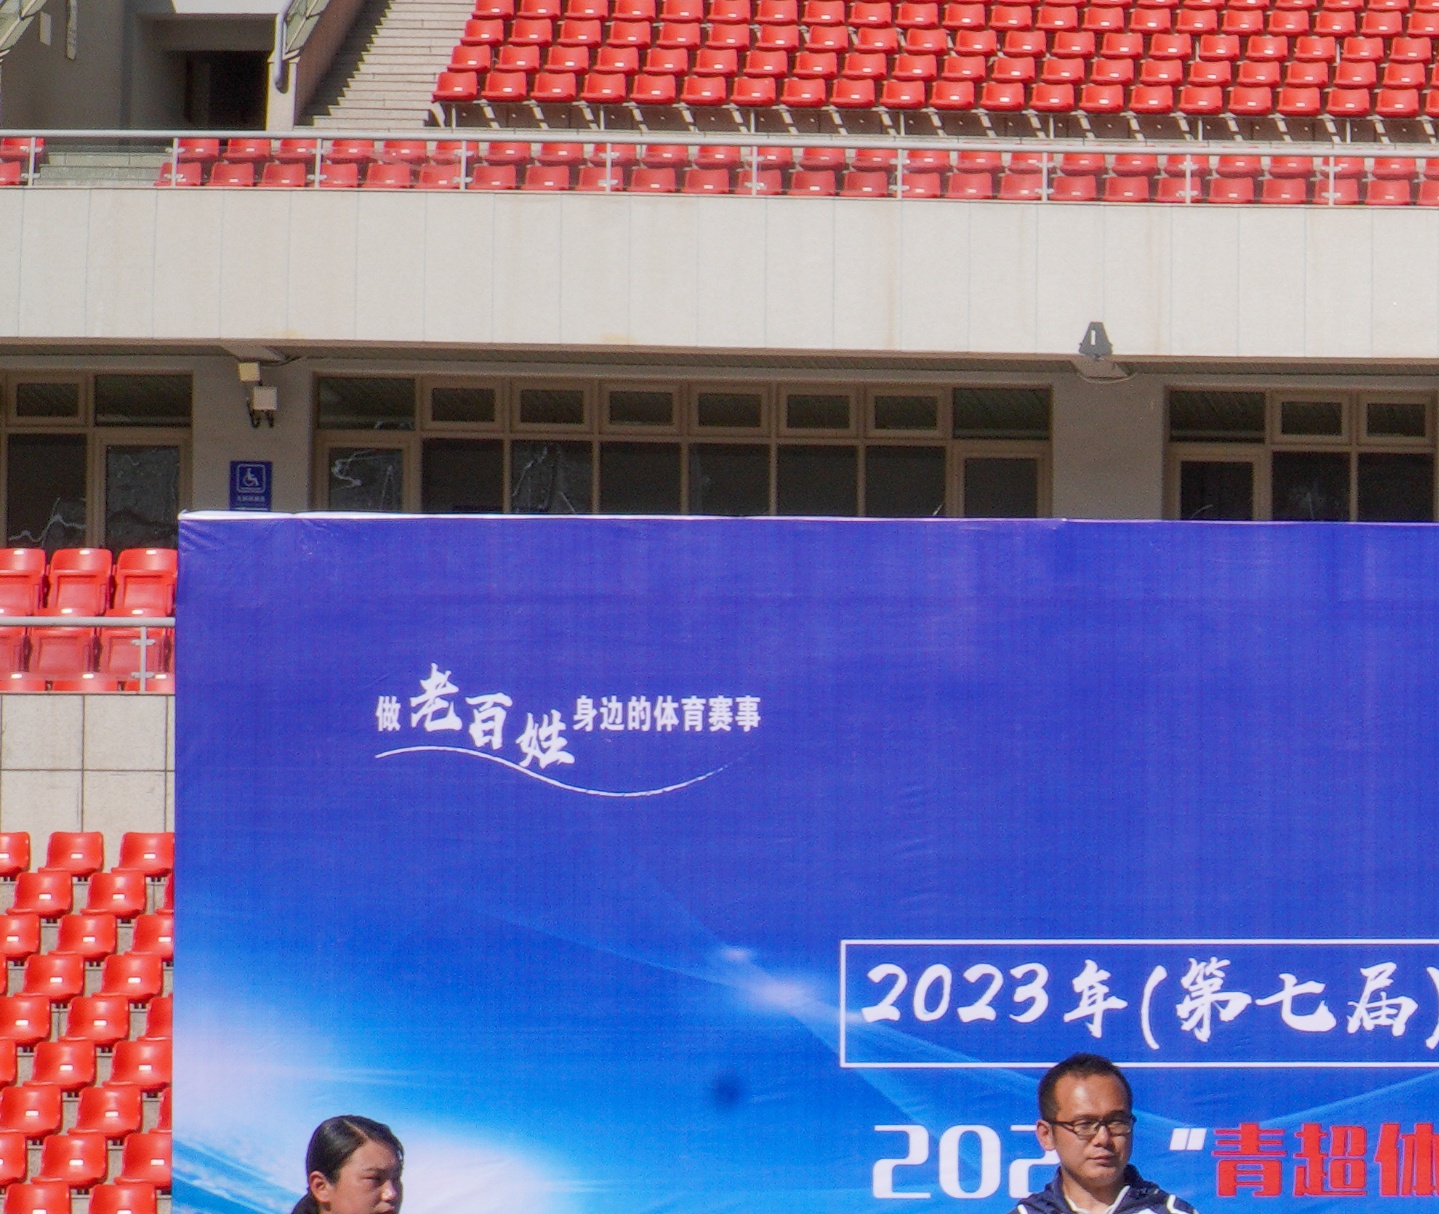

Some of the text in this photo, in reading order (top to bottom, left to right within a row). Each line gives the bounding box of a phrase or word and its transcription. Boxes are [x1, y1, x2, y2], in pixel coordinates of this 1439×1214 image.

[375, 663, 761, 769] 做老百姓身边的体育赛事
